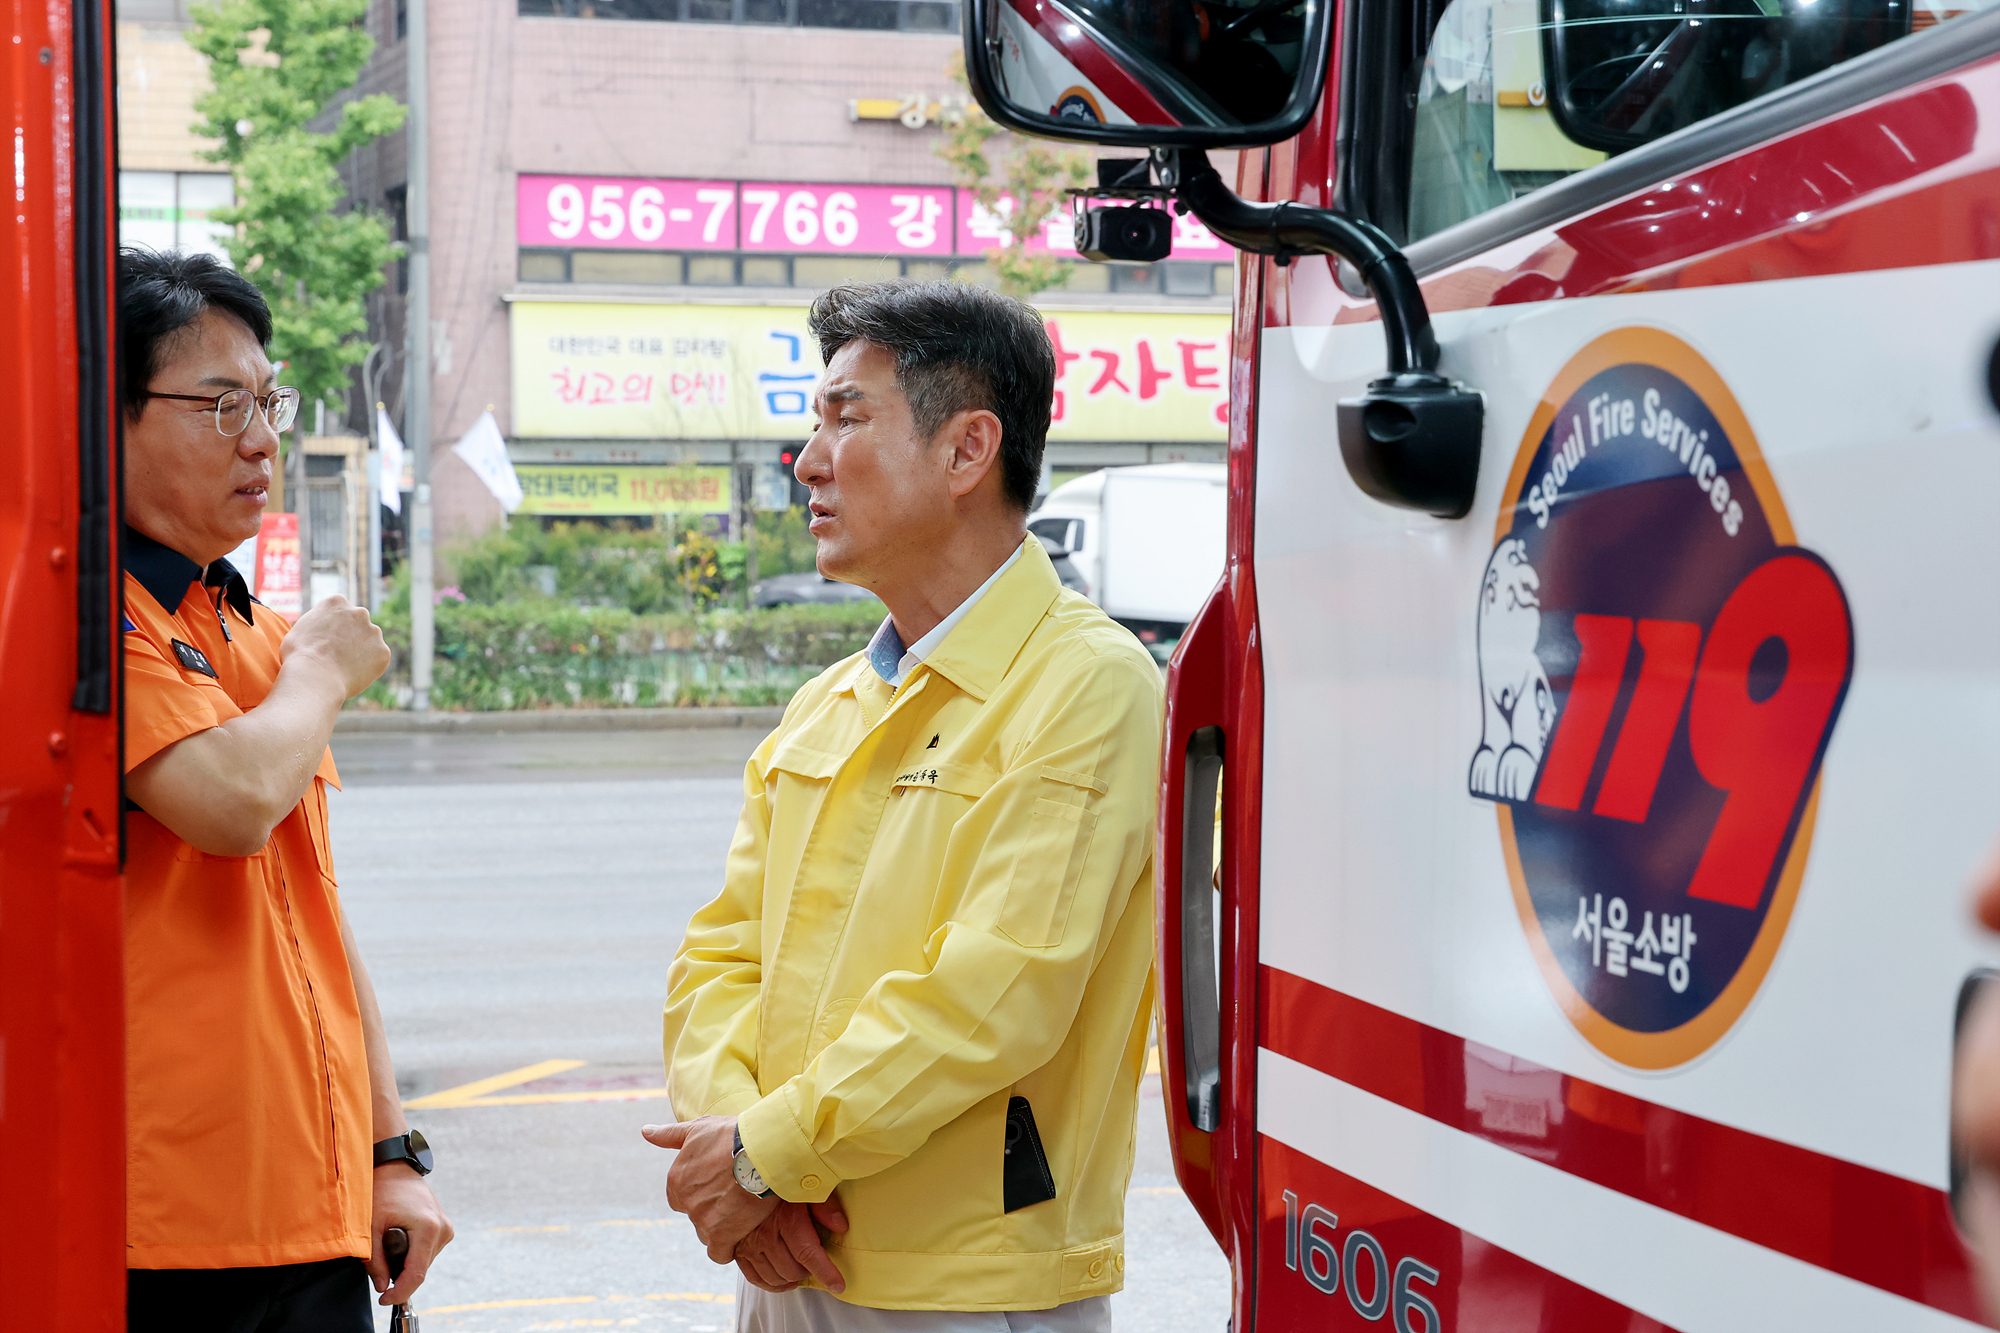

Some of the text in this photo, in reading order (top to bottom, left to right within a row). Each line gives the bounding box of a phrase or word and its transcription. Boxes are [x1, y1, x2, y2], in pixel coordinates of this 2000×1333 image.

[546, 183, 860, 247] 956-7766
[548, 335, 621, 356] 대한민국
[629, 336, 663, 356] 대표
[550, 366, 654, 404] 최고의
[1528, 387, 1743, 537] Seoul Fire Services
[1534, 554, 1850, 910] 119
[1571, 892, 1698, 994] 서울소방
[1281, 1188, 1442, 1333] 1606
